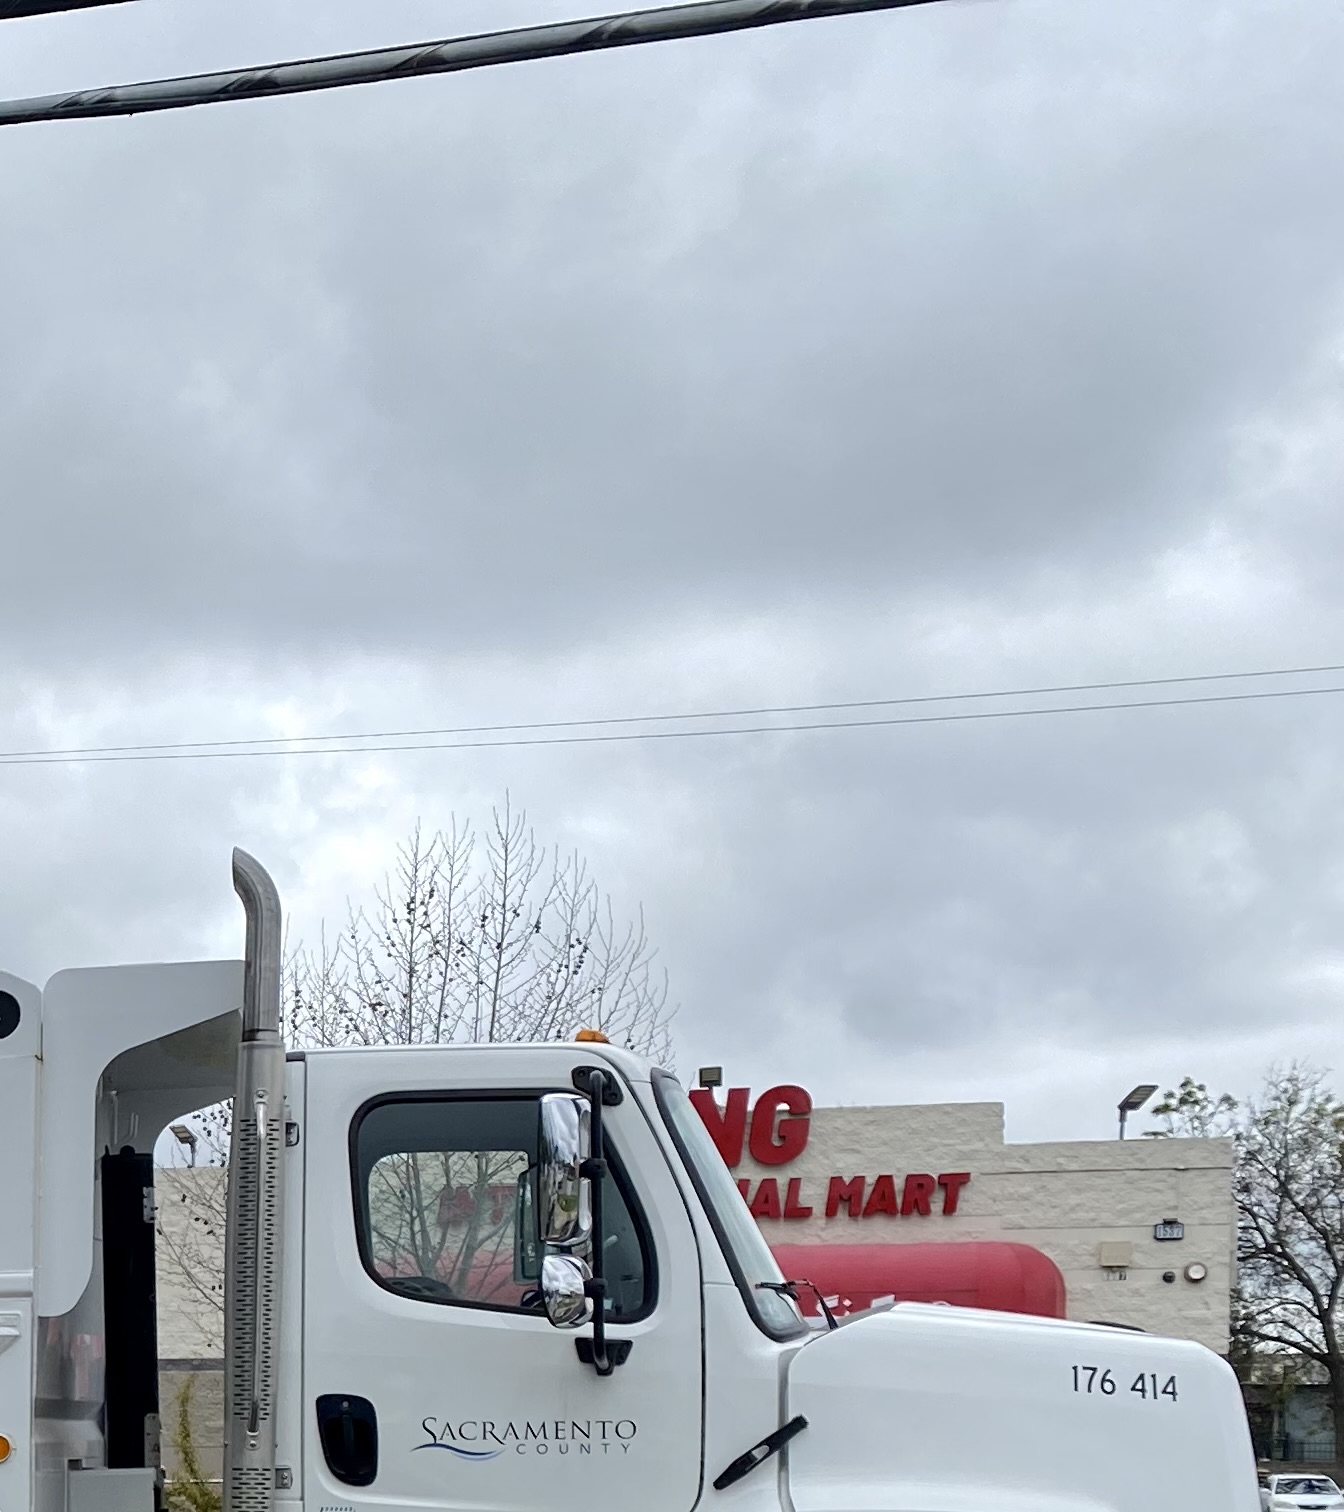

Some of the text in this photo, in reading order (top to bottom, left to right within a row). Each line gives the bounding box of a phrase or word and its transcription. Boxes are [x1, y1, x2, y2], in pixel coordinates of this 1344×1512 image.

[825, 1172, 971, 1218] MART
[1070, 1364, 1179, 1402] 176 414
[421, 1416, 637, 1445] SACRAMENTO
[516, 1443, 632, 1455] COUNTY
